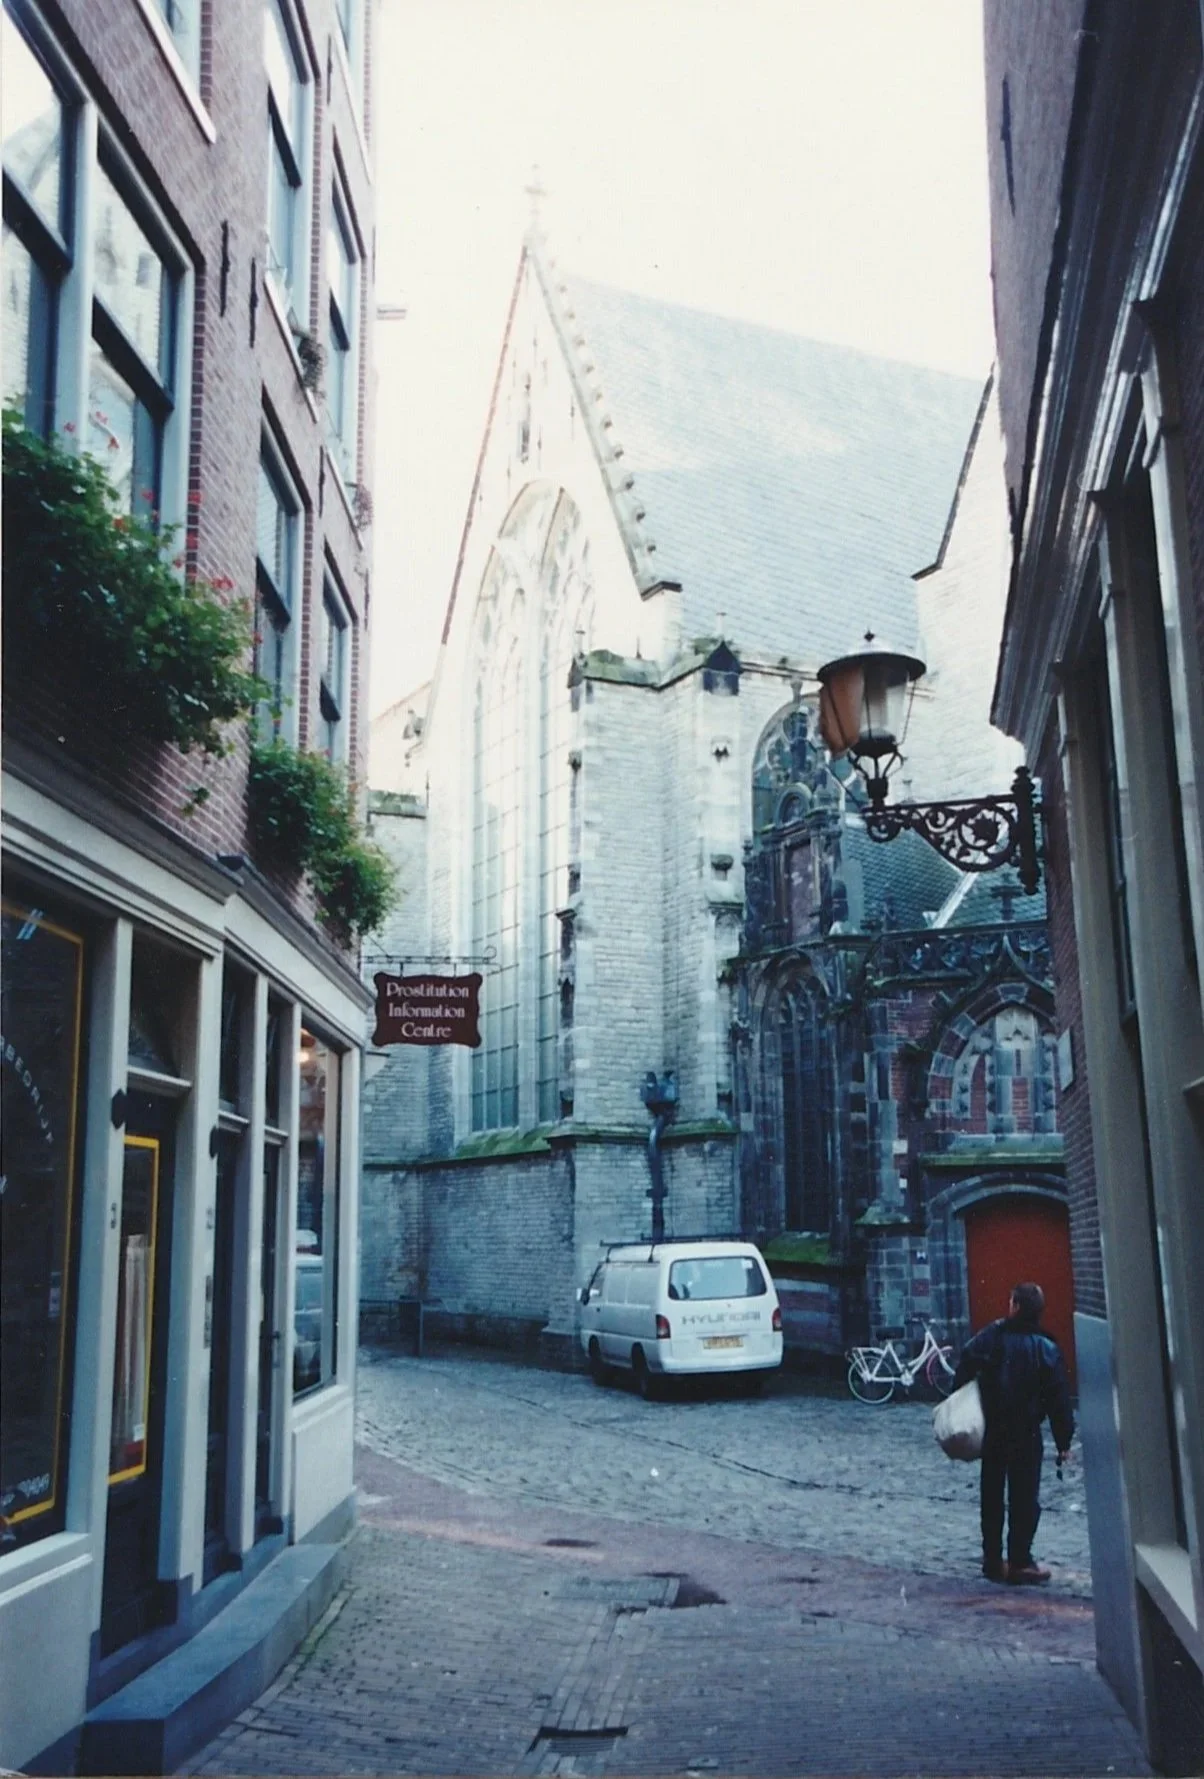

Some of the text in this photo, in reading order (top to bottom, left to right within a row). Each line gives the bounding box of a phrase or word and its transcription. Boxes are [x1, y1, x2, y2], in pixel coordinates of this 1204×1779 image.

[386, 982, 469, 998] Prostitution
[389, 1002, 465, 1018] Information
[401, 1022, 452, 1038] Centre
